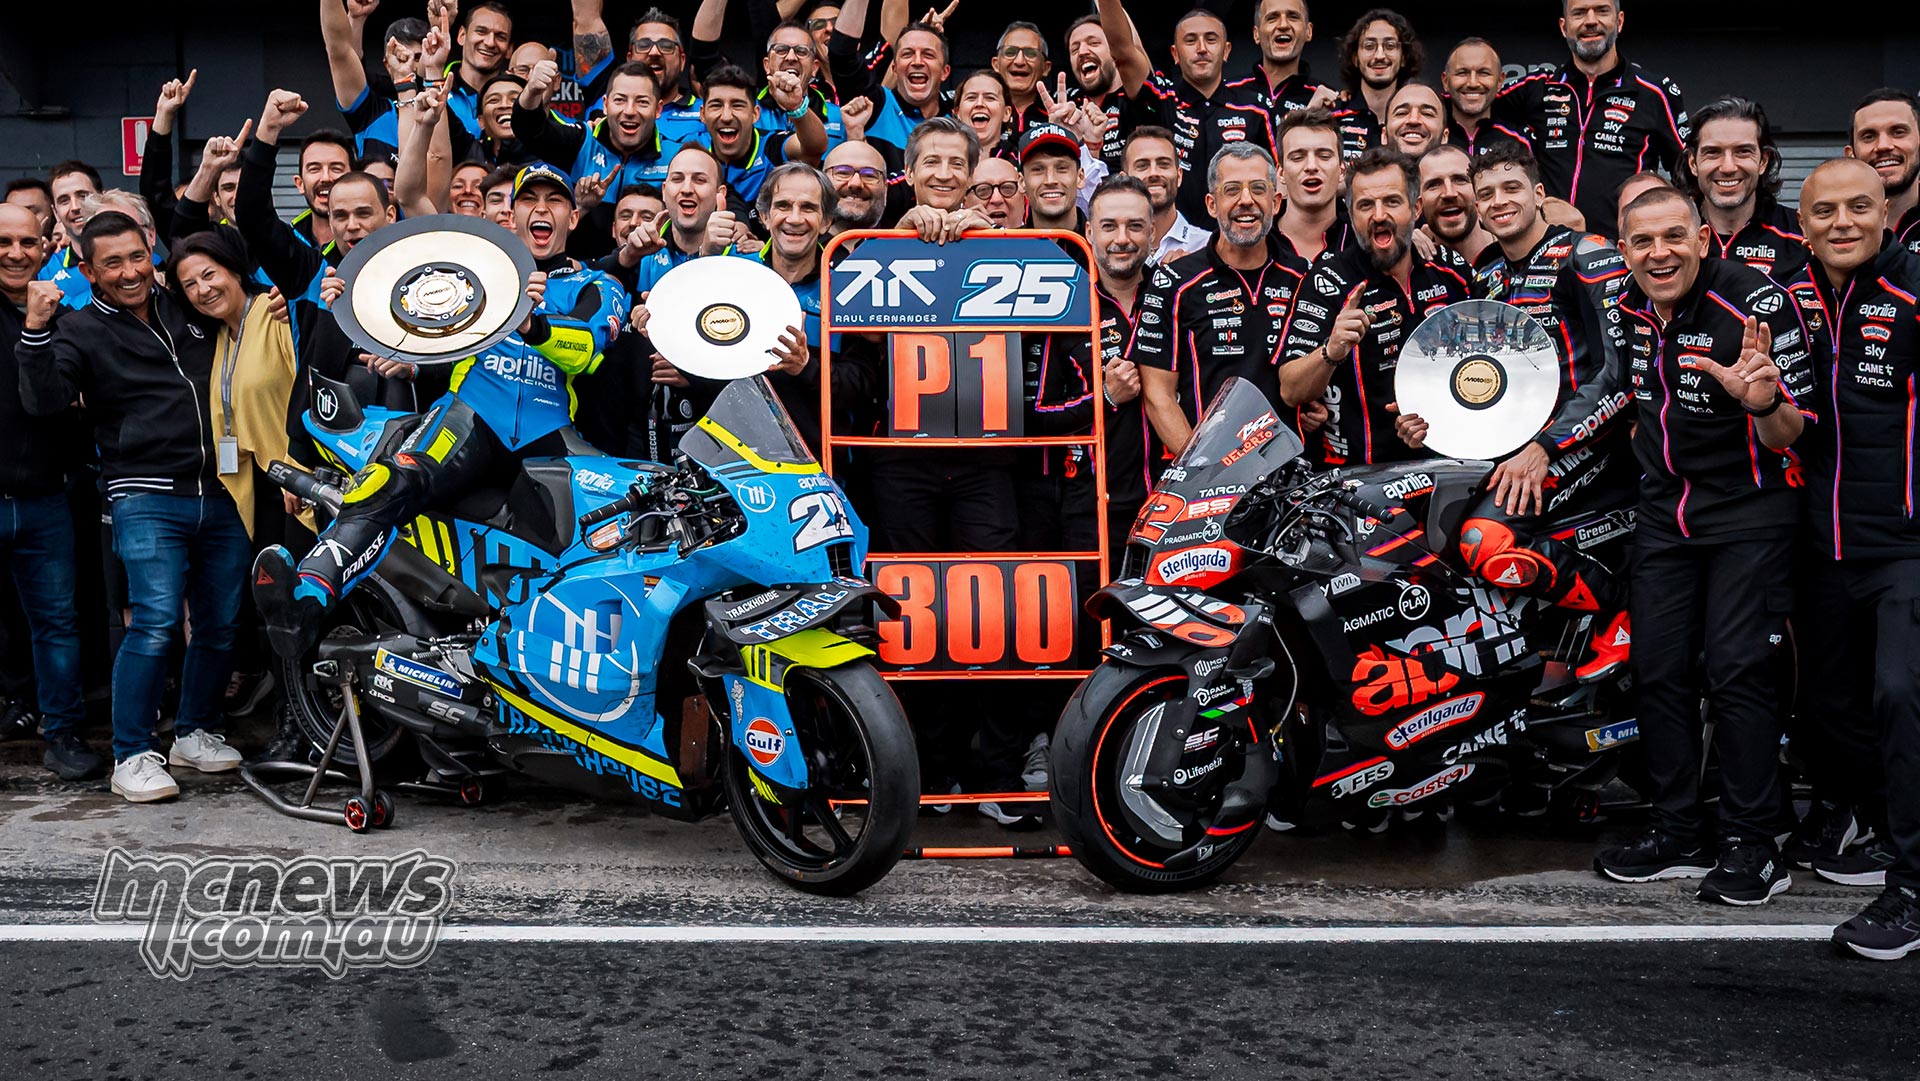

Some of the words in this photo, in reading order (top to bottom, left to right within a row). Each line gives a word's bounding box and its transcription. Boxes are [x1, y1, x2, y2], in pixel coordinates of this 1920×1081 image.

[1606, 96, 1636, 108] aprilia
[1217, 116, 1246, 128] aprilia
[1603, 121, 1622, 133] sky
[1030, 125, 1066, 139] aprilia
[1104, 130, 1119, 140] sky
[1595, 132, 1617, 143] CAME
[1594, 142, 1623, 152] TARGA
[1736, 245, 1775, 258] aprilia
[957, 261, 1079, 319] 25
[1214, 287, 1242, 301] Castrol
[1417, 284, 1447, 301] aprilia
[1526, 304, 1552, 315] Castrol
[1859, 303, 1897, 318] aprilia
[835, 314, 865, 323] RAUL
[869, 314, 937, 323] FERNANDEZ
[1213, 317, 1242, 326] BS
[1377, 328, 1402, 343] BS
[1677, 333, 1714, 348] aprilia
[554, 339, 588, 353] TRACKHOUSE
[1864, 343, 1886, 360] sky
[484, 353, 556, 385] aprilia
[1632, 358, 1648, 368] BS
[1858, 362, 1884, 375] CAME
[503, 374, 557, 391] RACING
[1680, 372, 1702, 389] sky
[1855, 375, 1893, 388] TARGA
[1677, 388, 1700, 402] CAME
[1572, 391, 1629, 441] aprilia
[269, 463, 293, 480] SC
[575, 468, 616, 491] aprilia
[797, 475, 833, 490] aprilia
[1382, 471, 1433, 500] aprilia
[1199, 484, 1247, 498] TARGA
[1403, 486, 1434, 500] RACING
[1188, 498, 1233, 514] BS
[1165, 531, 1203, 545] PRAGMATIC
[1577, 523, 1612, 541] Green
[342, 530, 385, 584] DAINESE
[1161, 550, 1227, 578] sterilgarda
[725, 589, 780, 620] TRACKHOUSE
[876, 563, 1073, 666] 300
[1344, 606, 1395, 633] AGMATIC
[1402, 594, 1428, 612] PLAY
[1769, 634, 1782, 645] ap
[398, 664, 455, 689] MICHELIN
[1210, 685, 1227, 696] PAN
[428, 701, 466, 723] SC
[1392, 697, 1476, 743] sterilgarda
[746, 731, 783, 752] Gulf
[1185, 726, 1220, 747] SC
[1187, 757, 1223, 780] Lifenet.it
[1352, 764, 1389, 790] FES
[1393, 764, 1469, 804] Castrol
